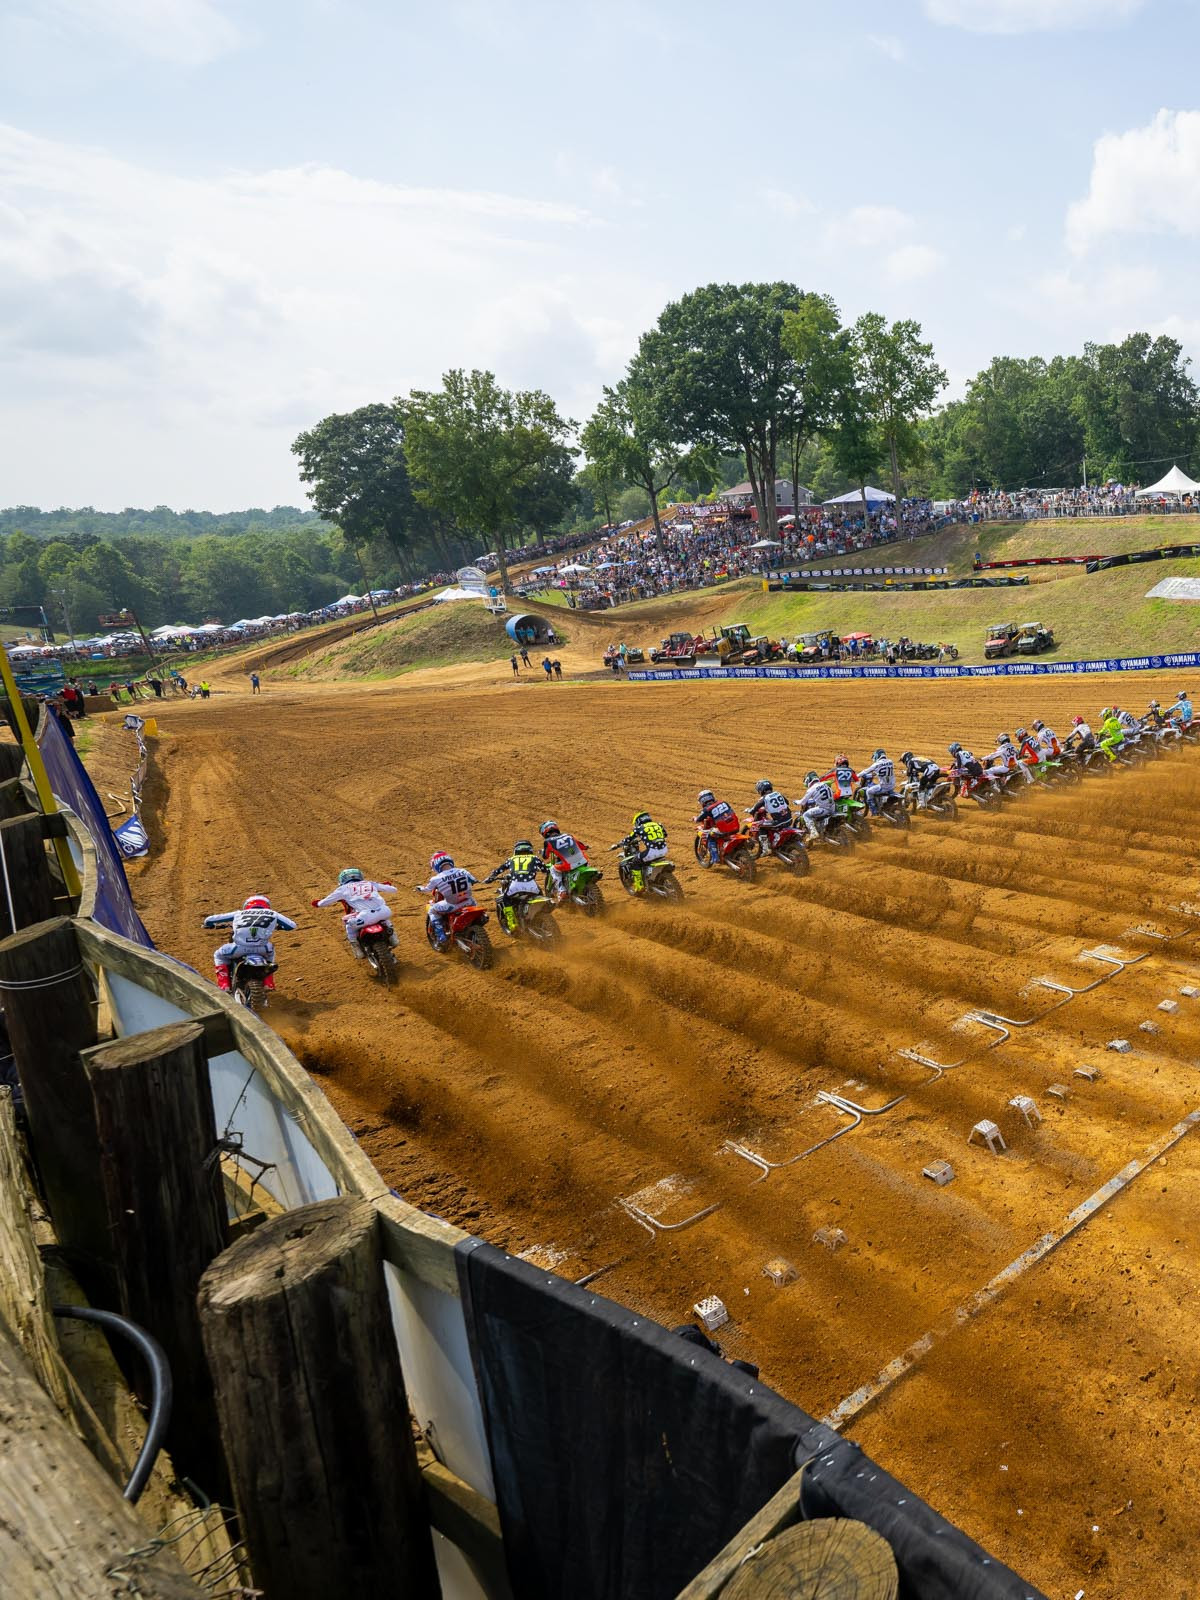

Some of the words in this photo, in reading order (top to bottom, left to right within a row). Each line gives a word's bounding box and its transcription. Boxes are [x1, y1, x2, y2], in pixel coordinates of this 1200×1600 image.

[1126, 658, 1149, 667] YAMAHA
[1171, 654, 1196, 664] YAMAHA
[837, 770, 852, 781] 29
[819, 787, 832, 801] 31
[770, 795, 784, 809] 39
[644, 825, 665, 841] 33
[512, 856, 532, 871] 17
[448, 877, 468, 895] 16
